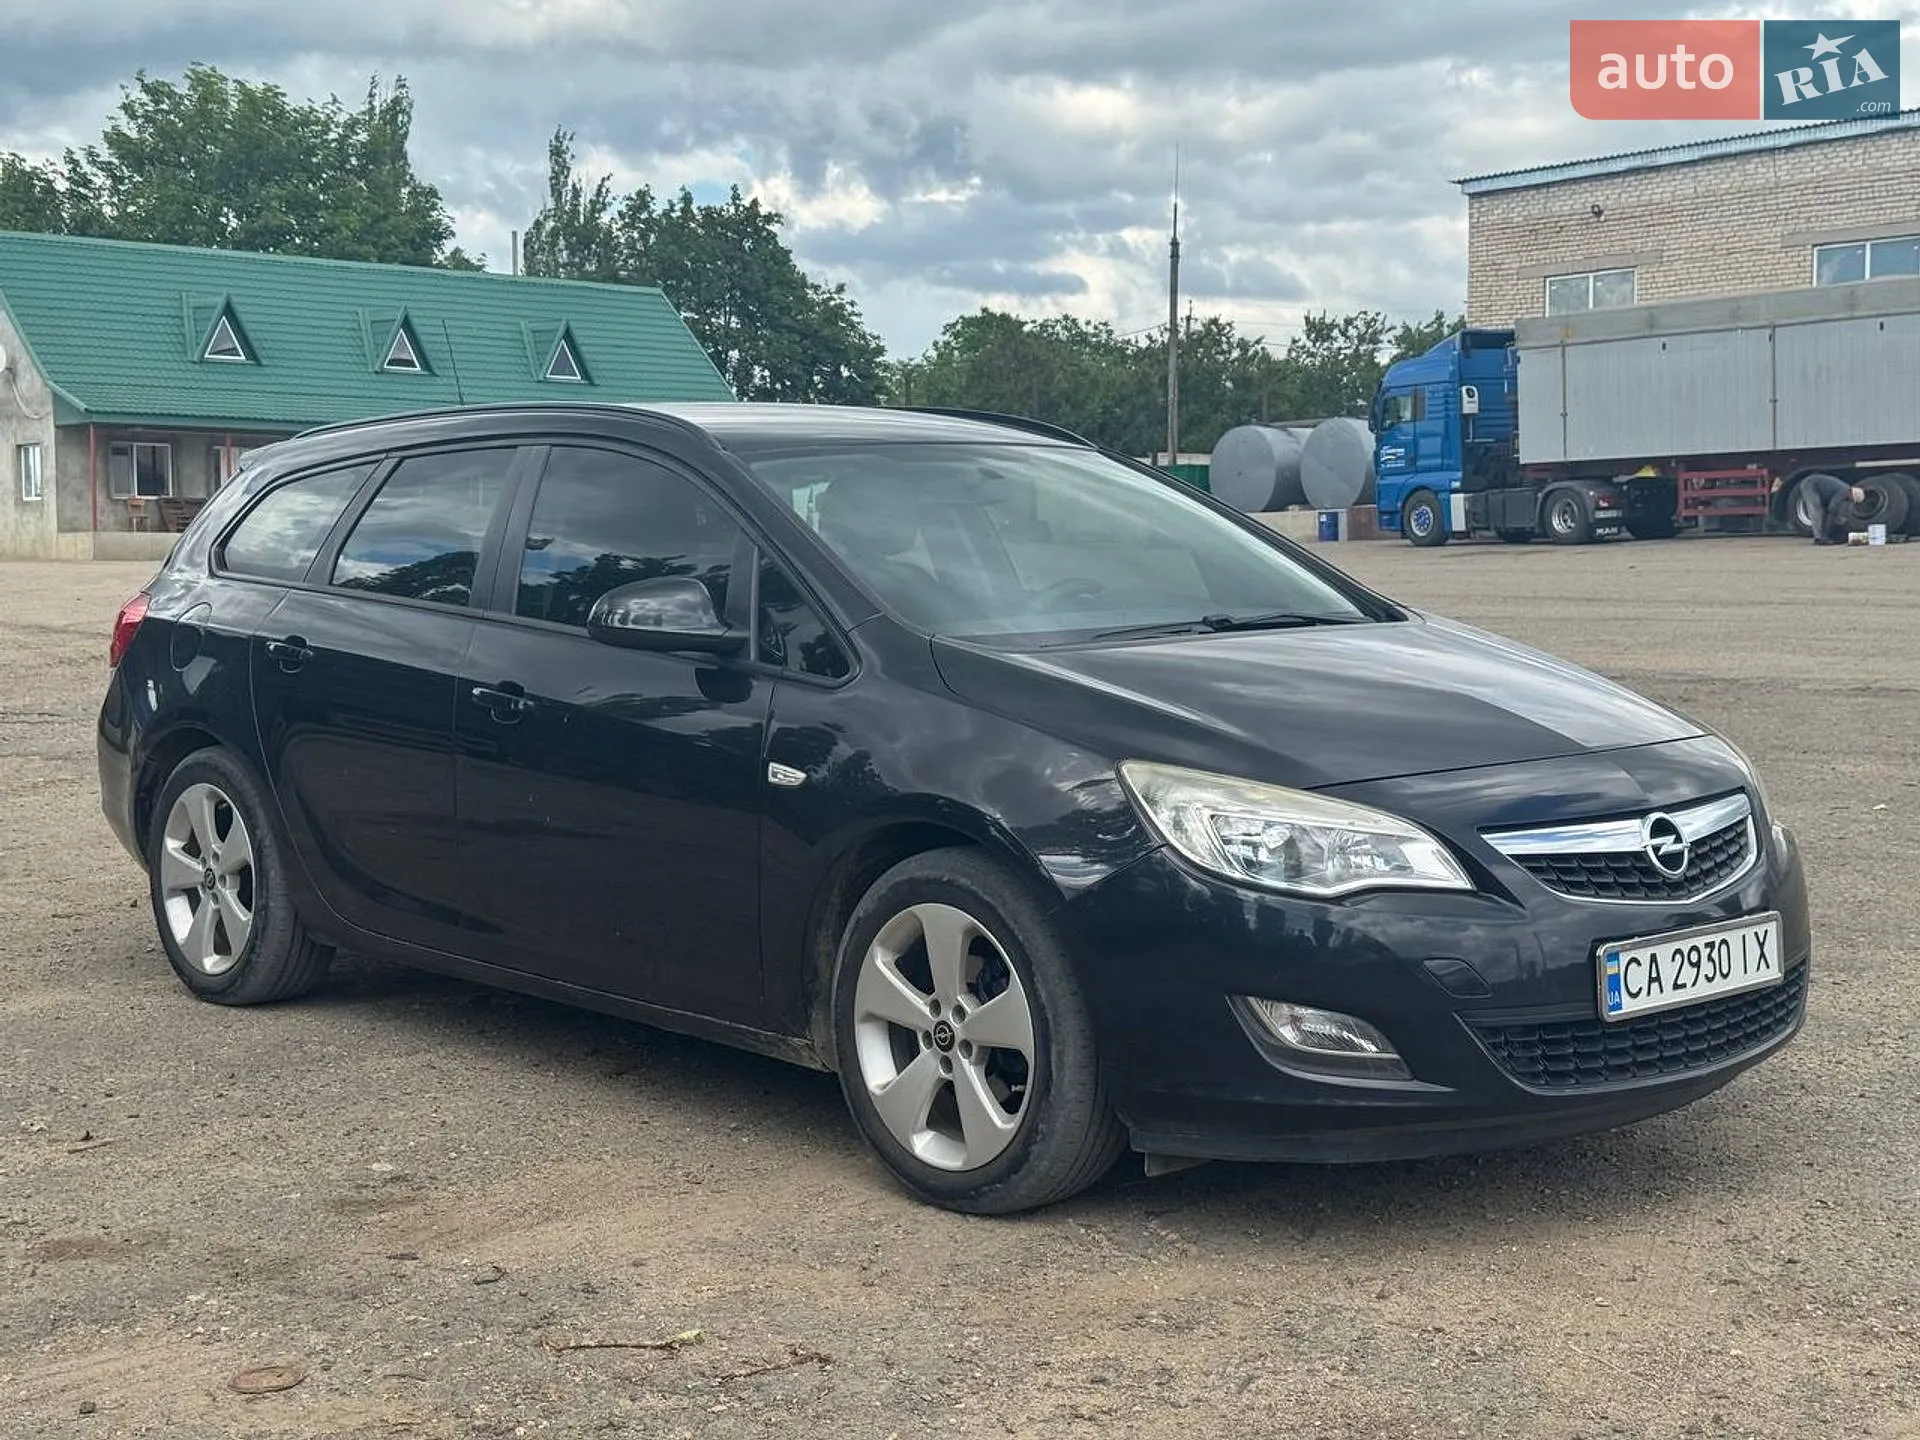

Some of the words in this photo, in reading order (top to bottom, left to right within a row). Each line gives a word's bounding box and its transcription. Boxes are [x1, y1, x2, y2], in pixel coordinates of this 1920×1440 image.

[1623, 953, 1664, 999] CA
[1671, 938, 1732, 991] 2930
[1742, 929, 1770, 975] IX
[1607, 991, 1621, 1005] UA
